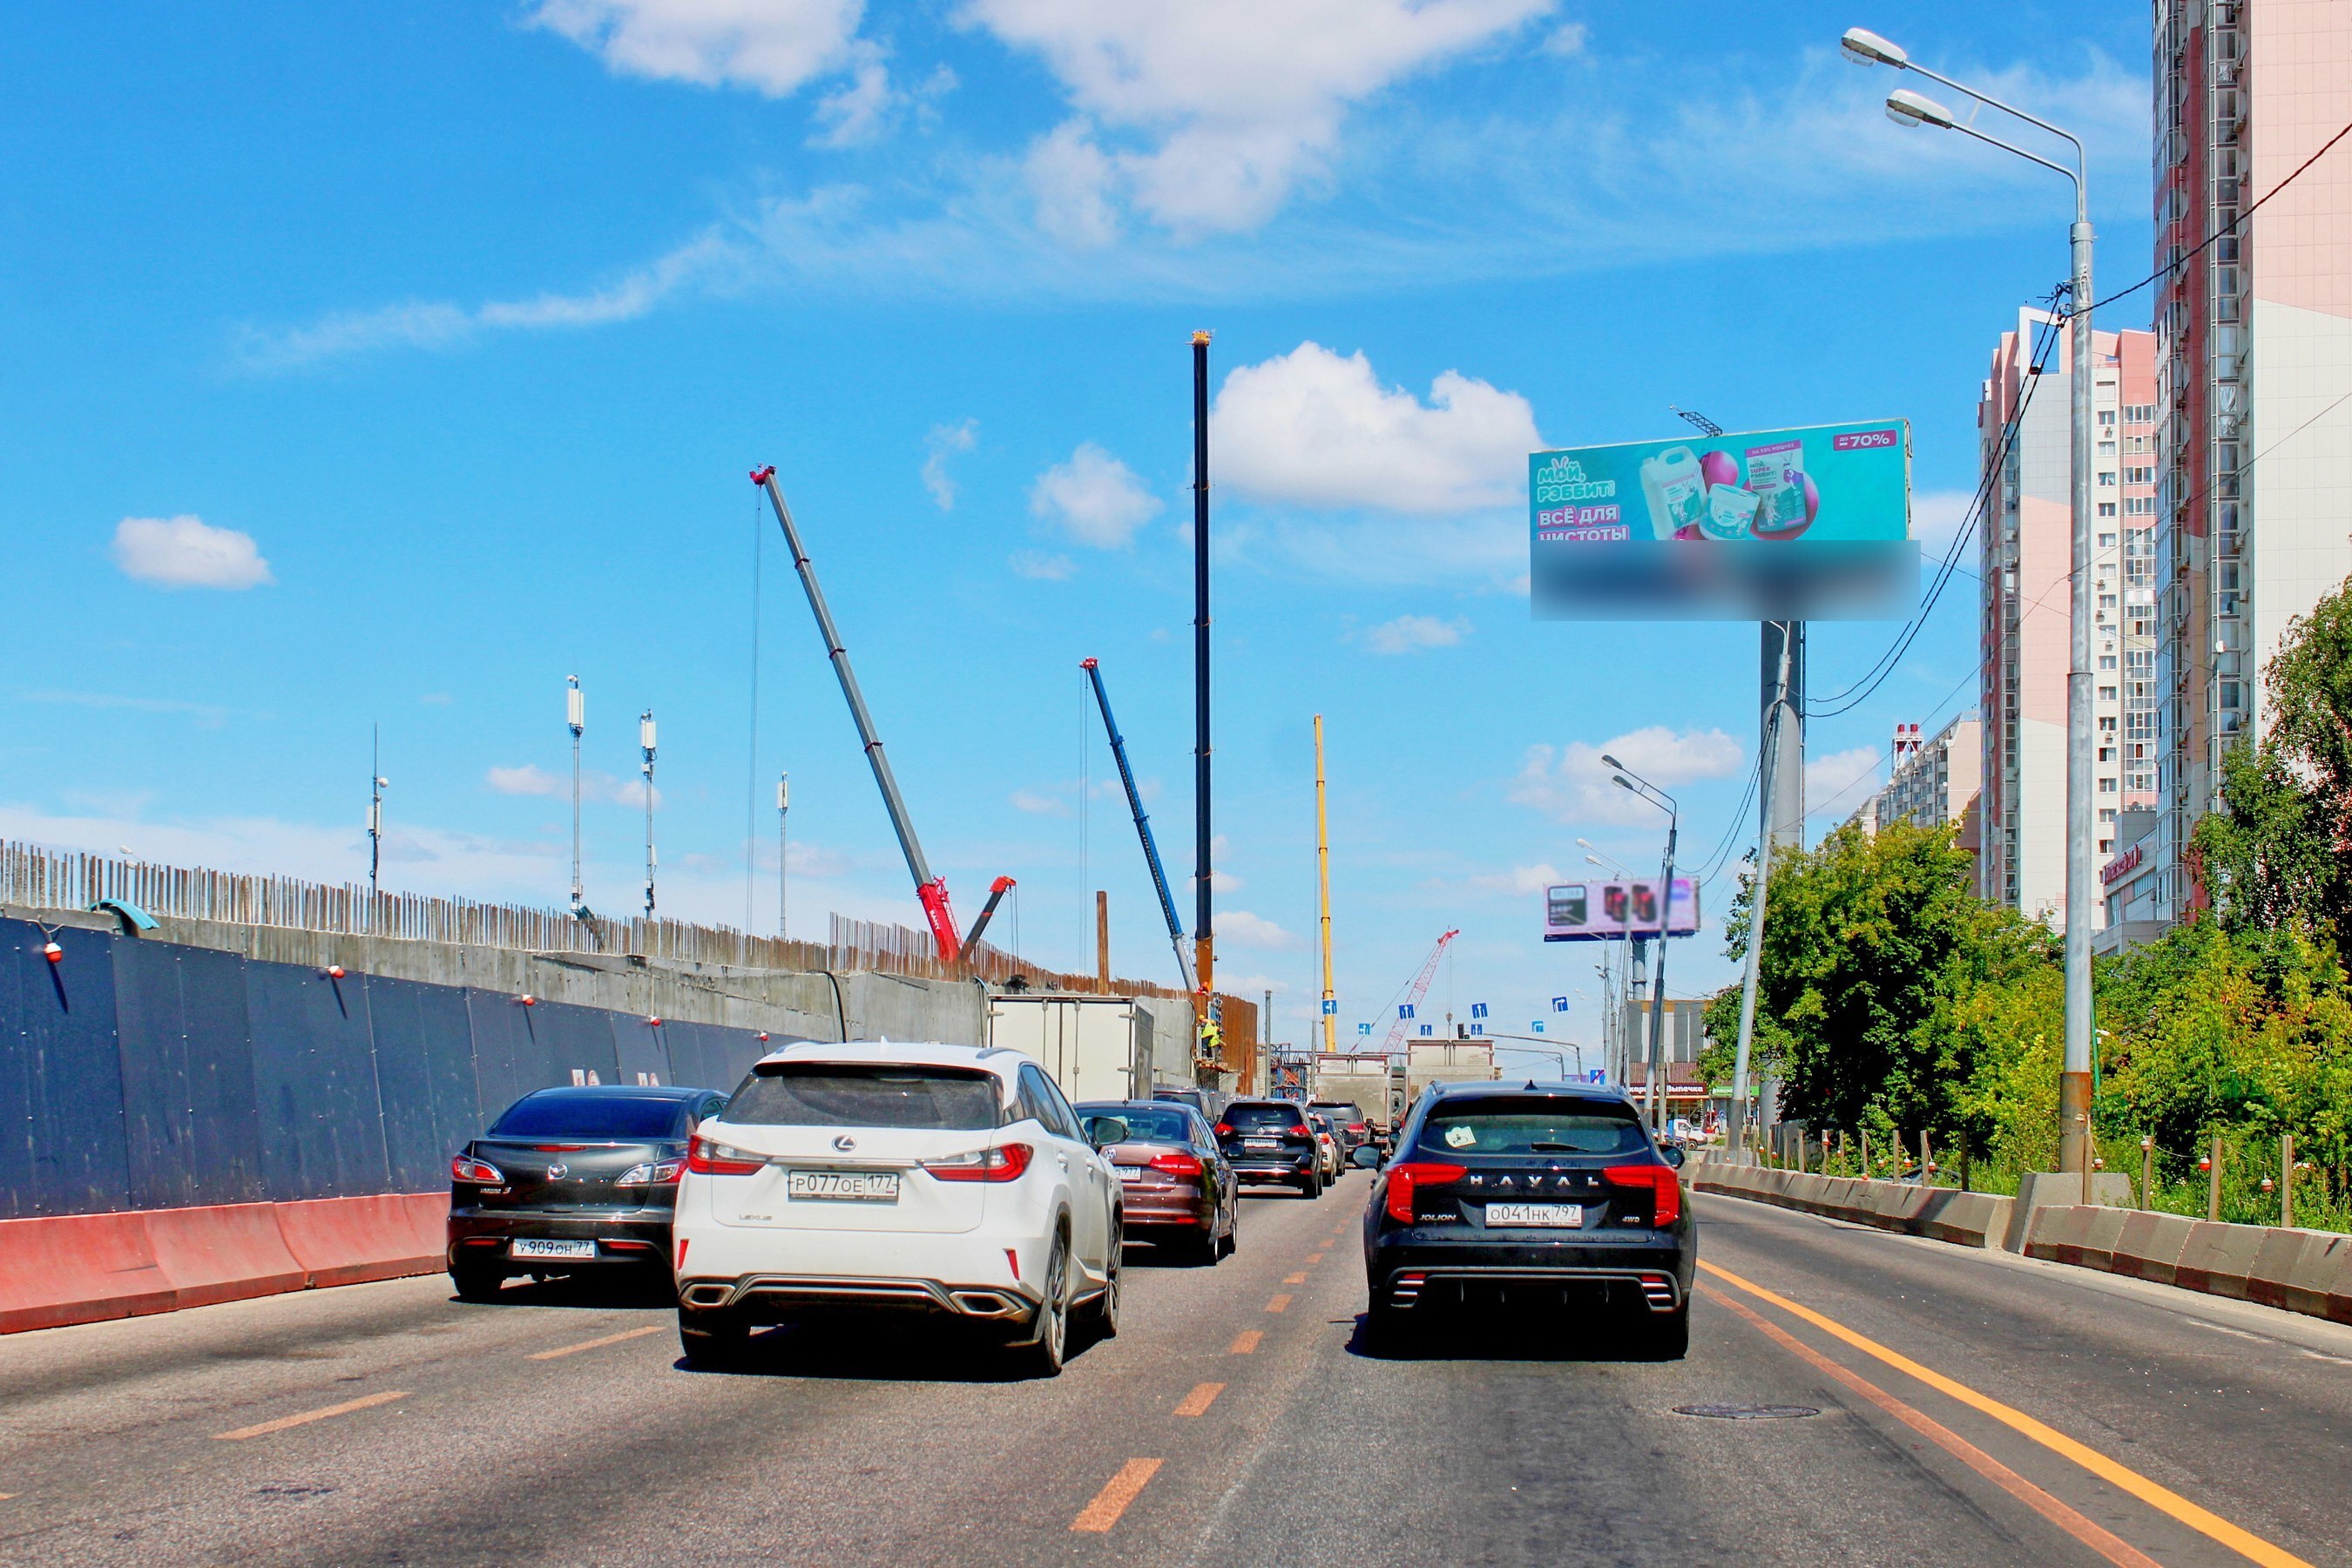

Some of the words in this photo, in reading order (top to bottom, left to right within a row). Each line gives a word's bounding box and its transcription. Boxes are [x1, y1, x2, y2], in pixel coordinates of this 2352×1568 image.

[1539, 508, 1574, 526] ВСЁ
[1578, 507, 1618, 524] ДЛЯ
[929, 909, 941, 929] SANY
[868, 1174, 892, 1189] 177
[1470, 1176, 1599, 1186] HAVAL
[1554, 1205, 1577, 1218] 797
[576, 1241, 590, 1252] 77
